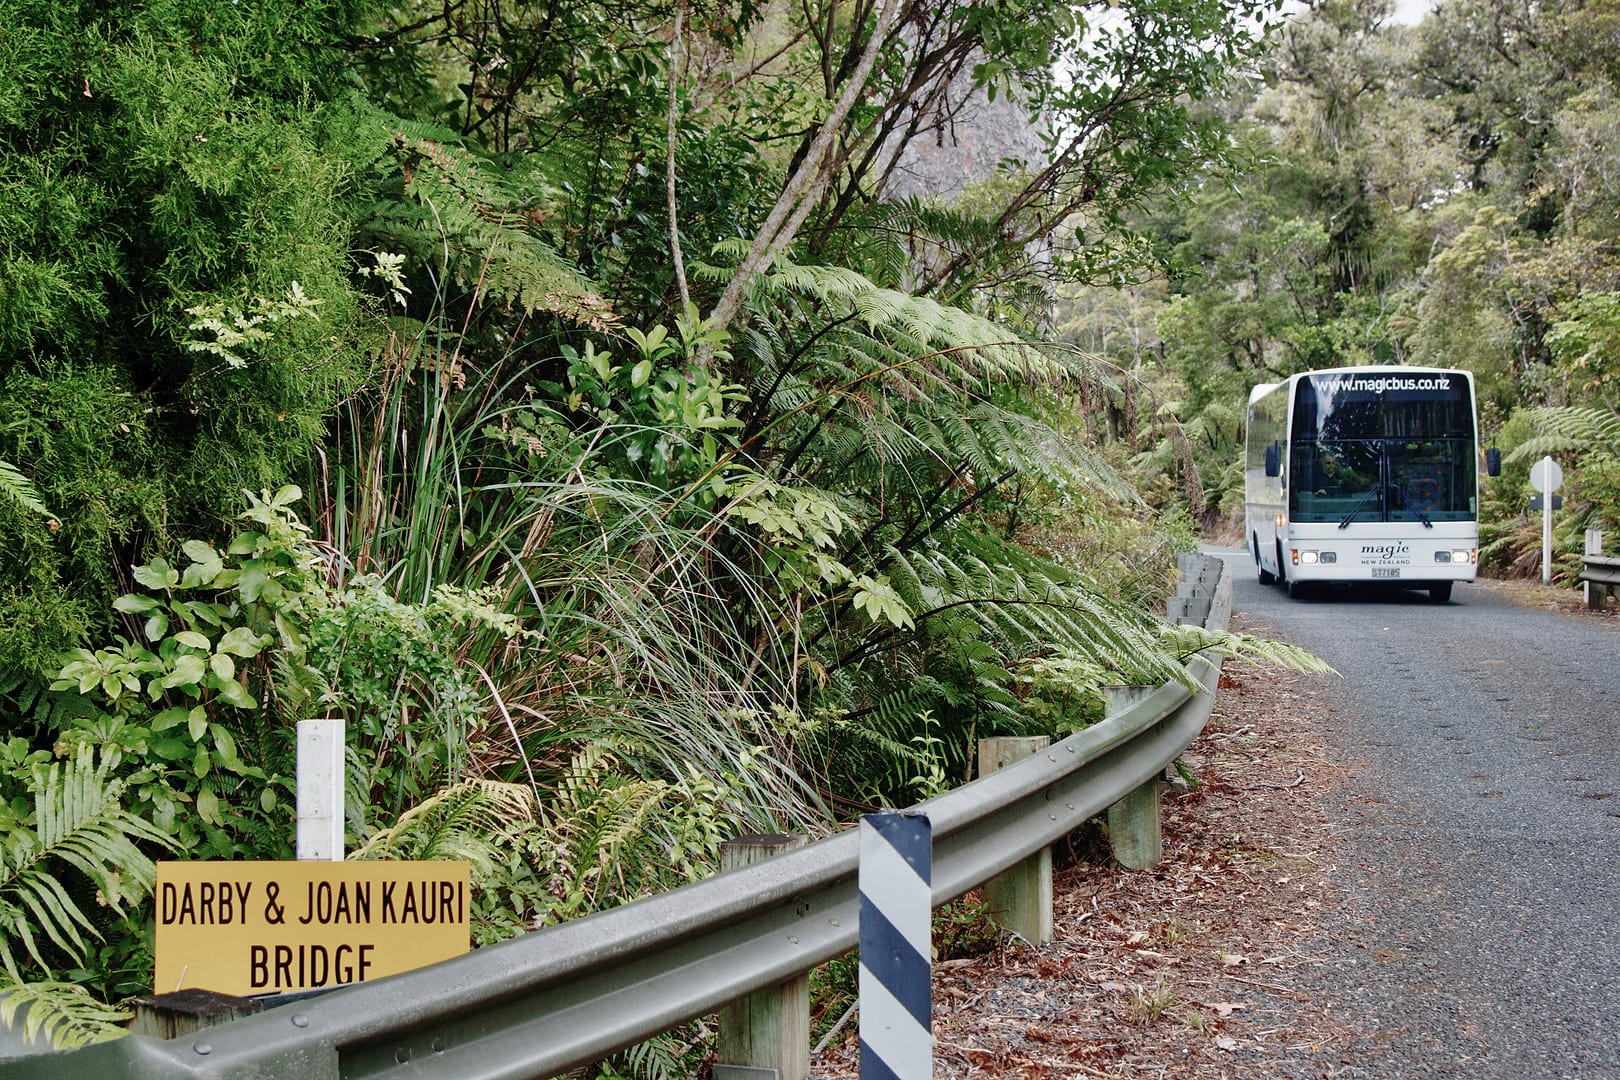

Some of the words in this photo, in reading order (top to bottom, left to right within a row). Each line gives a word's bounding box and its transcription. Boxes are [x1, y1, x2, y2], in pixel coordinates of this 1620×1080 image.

[1316, 377, 1450, 394] www.magicbus.co.nz
[1361, 541, 1410, 560] magic
[162, 882, 252, 925] DARBY
[264, 881, 285, 924] &
[298, 881, 371, 924] JOAN
[382, 881, 464, 924] KAURI
